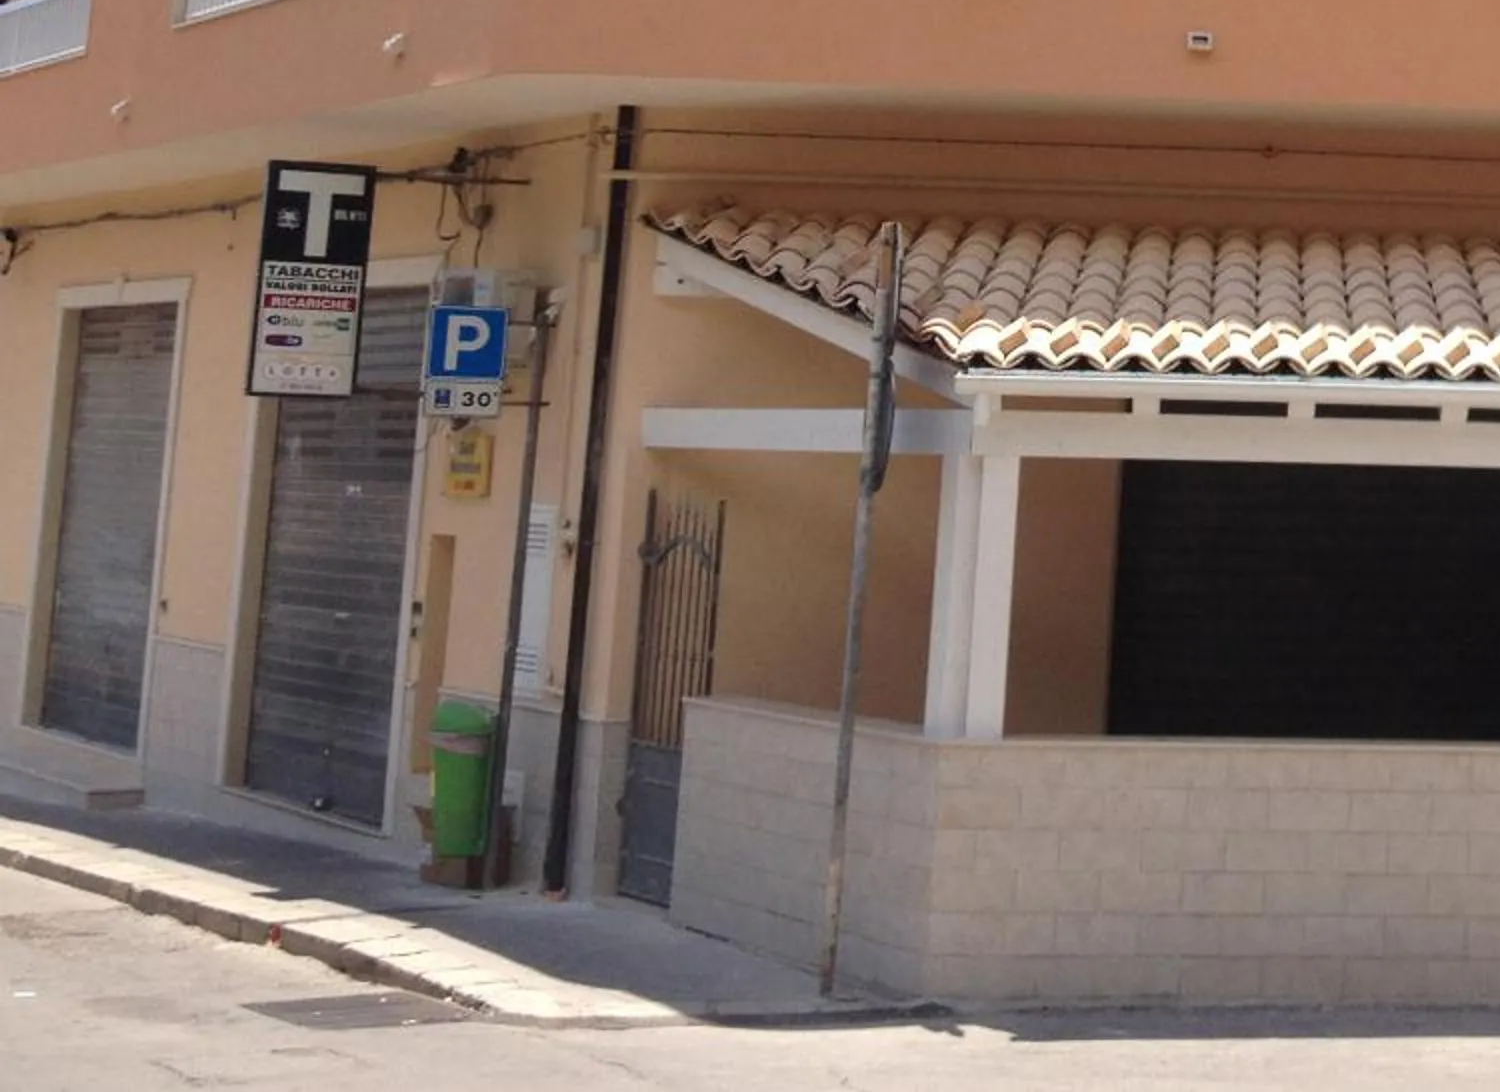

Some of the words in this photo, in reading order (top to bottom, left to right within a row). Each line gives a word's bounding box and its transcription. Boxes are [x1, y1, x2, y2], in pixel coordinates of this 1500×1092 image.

[278, 170, 366, 257] T
[268, 265, 359, 280] TABACCHI
[271, 295, 351, 310] RICARICHE
[444, 315, 491, 371] P
